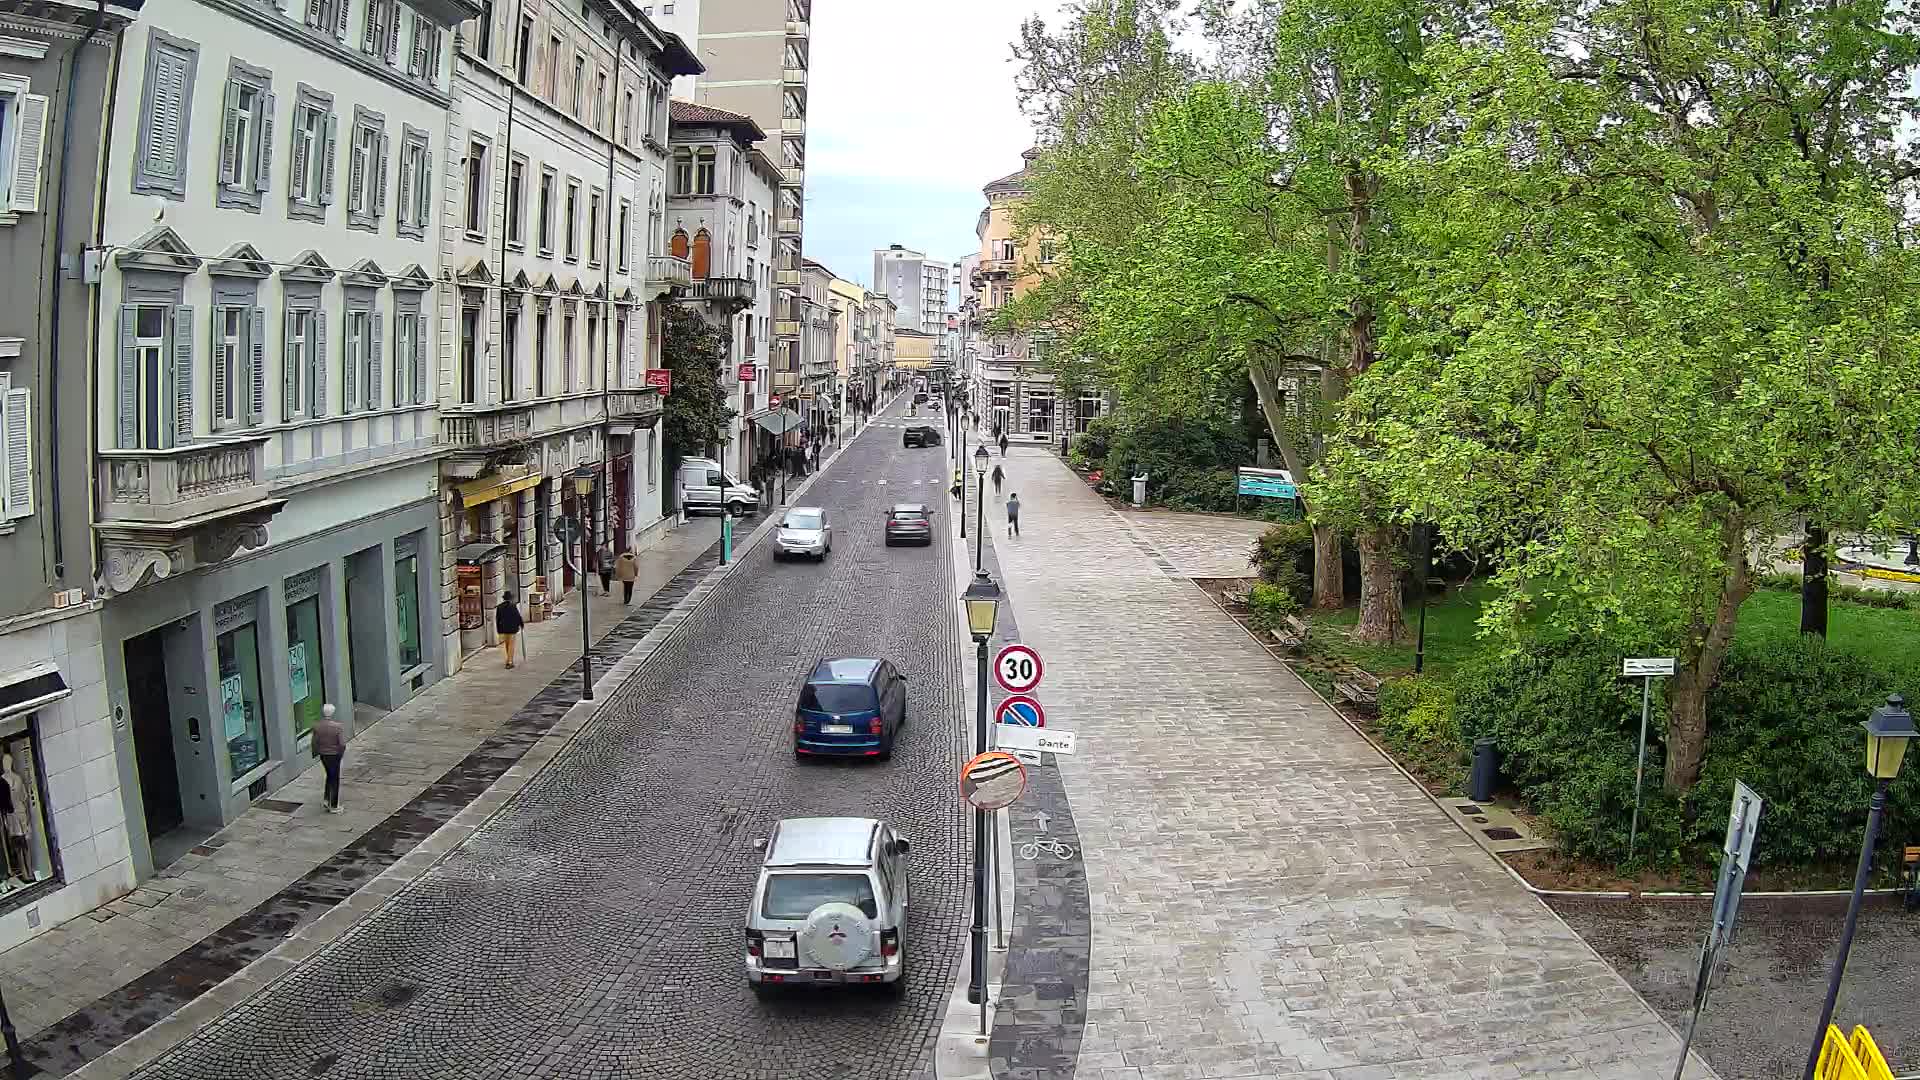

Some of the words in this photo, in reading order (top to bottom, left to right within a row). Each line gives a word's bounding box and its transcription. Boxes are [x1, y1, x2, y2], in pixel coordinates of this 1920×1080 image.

[1006, 658, 1032, 680] 30
[221, 677, 240, 700] 130
[1038, 738, 1069, 749] Dante
